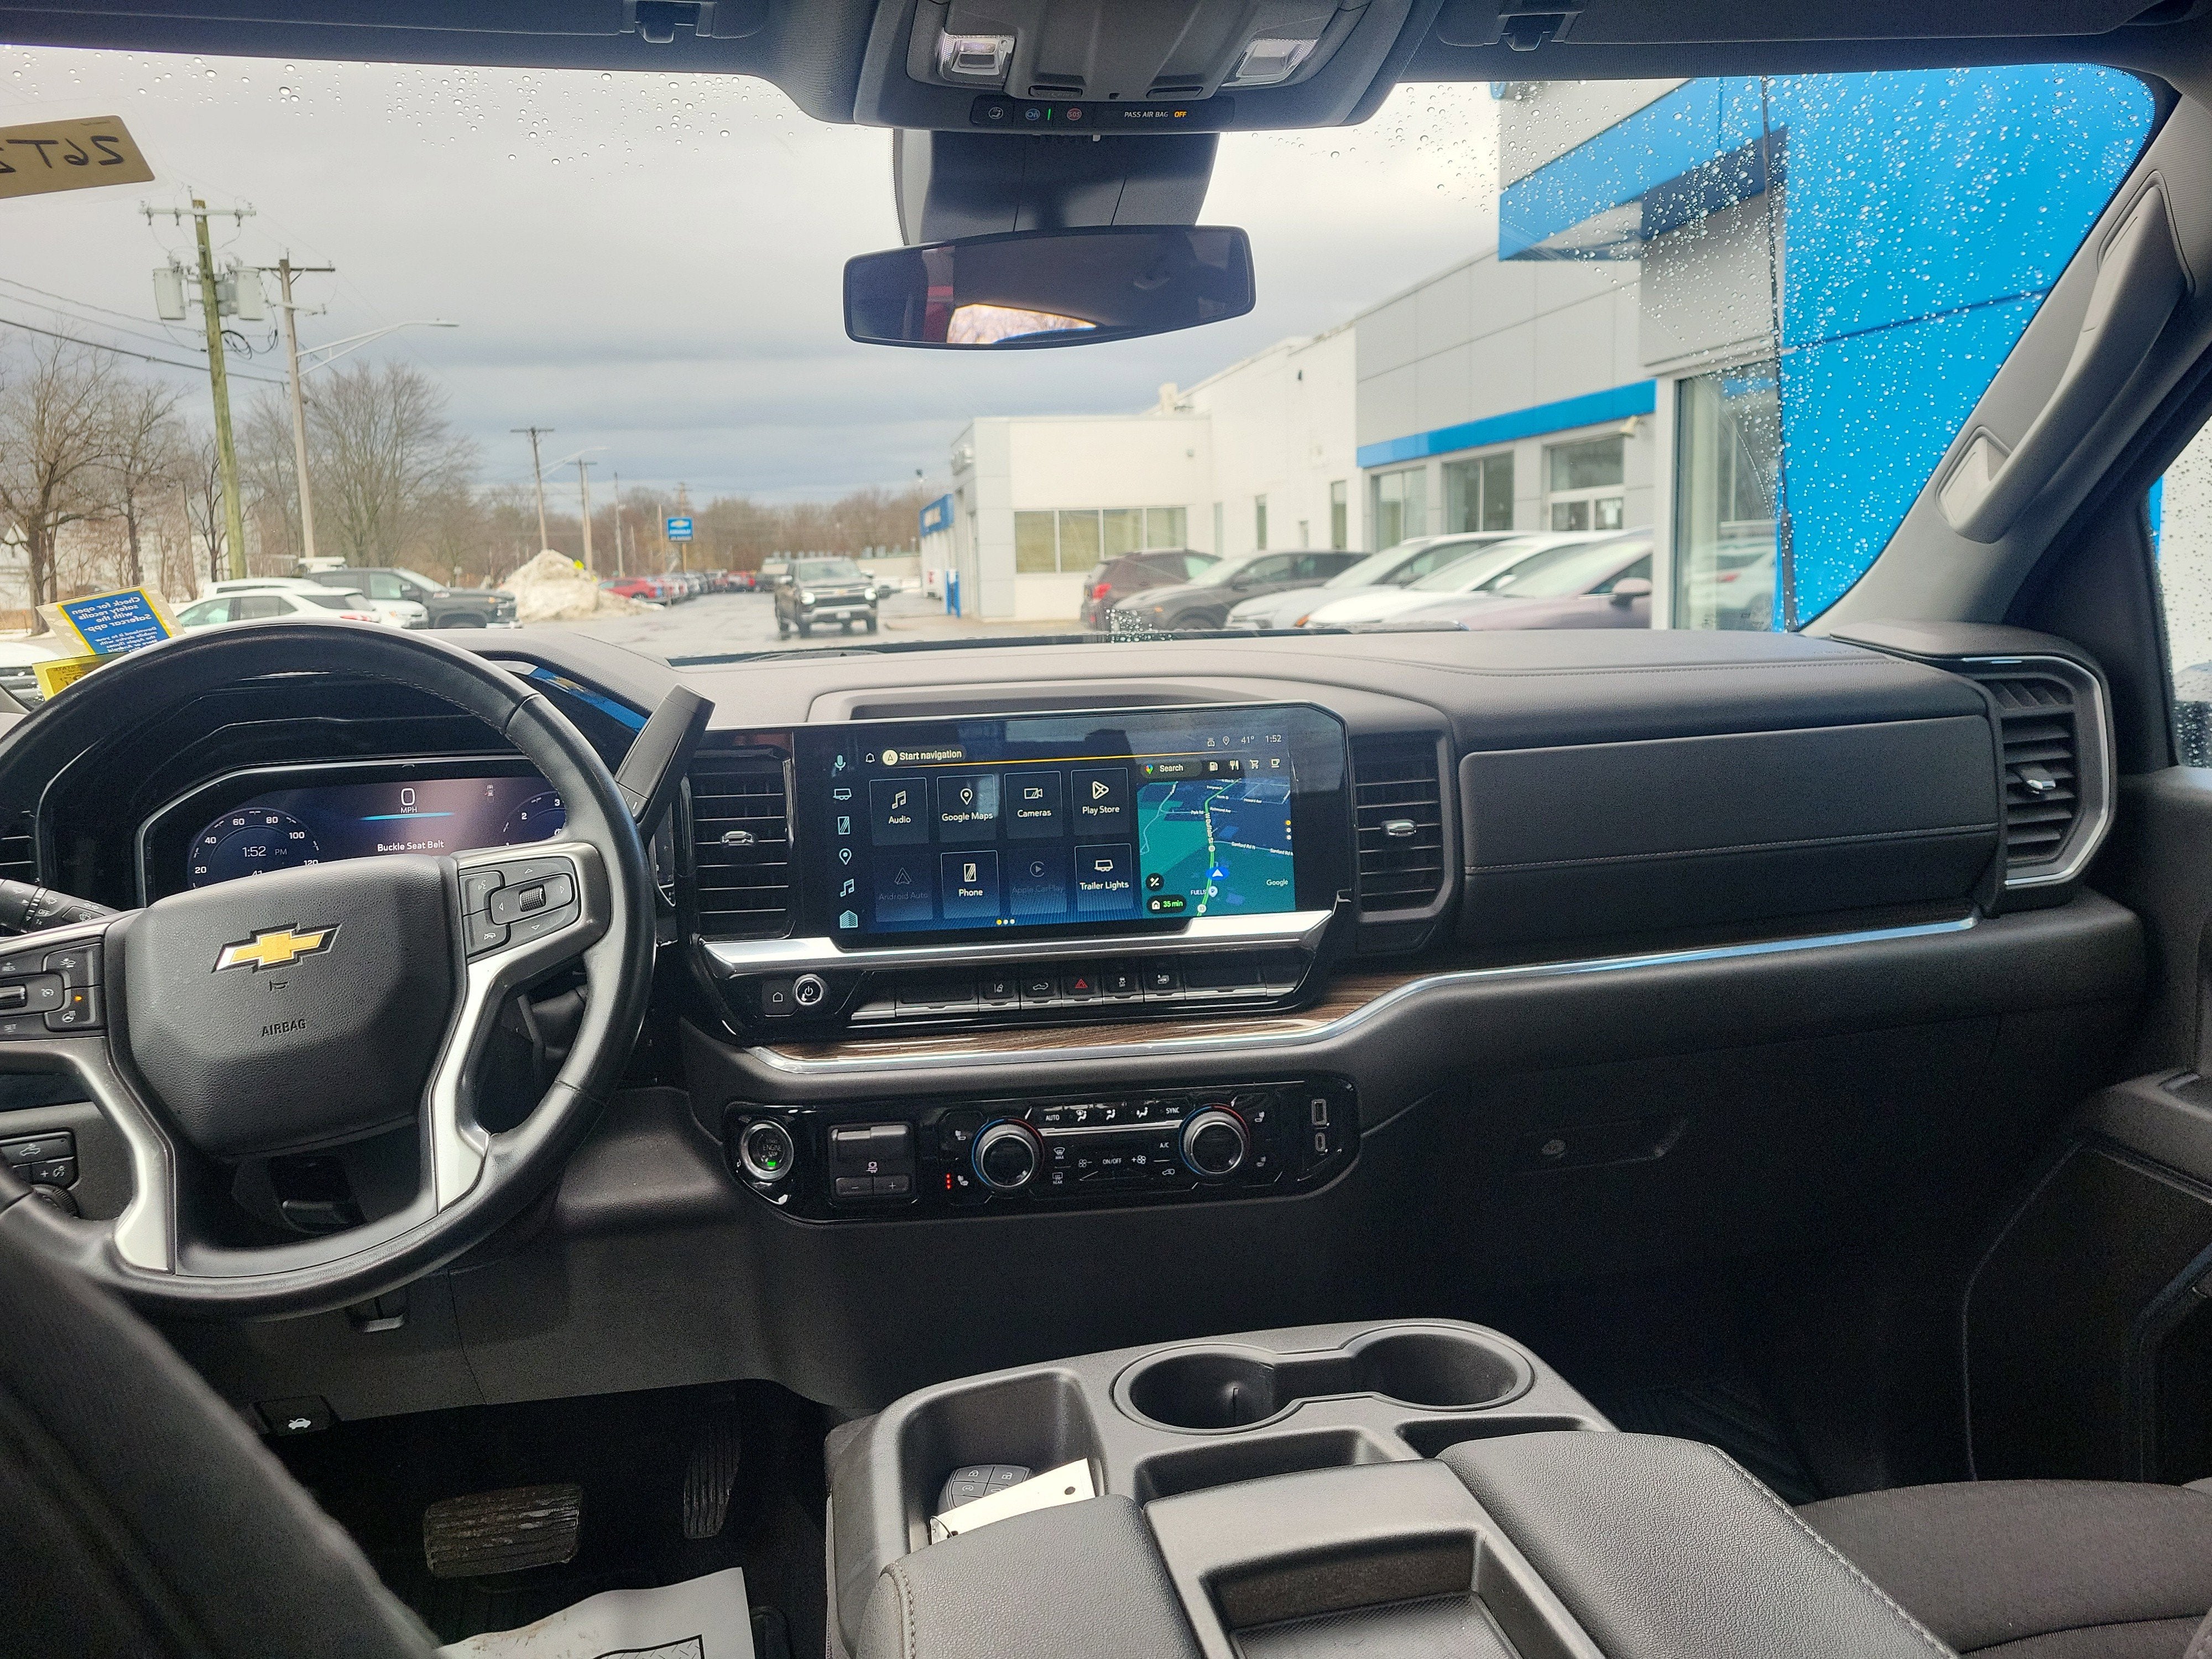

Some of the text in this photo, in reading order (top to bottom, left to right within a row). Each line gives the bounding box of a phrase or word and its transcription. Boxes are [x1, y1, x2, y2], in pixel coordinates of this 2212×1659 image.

[1241, 735, 1254, 744] 41°
[899, 750, 962, 760] Start navigation
[1159, 764, 1183, 773] Search
[401, 787, 415, 806] 0
[1017, 809, 1052, 817] Cameras
[1082, 805, 1120, 816] Play Store
[888, 816, 911, 825] Audio
[941, 812, 994, 823] Google Maps
[289, 831, 305, 839] 100
[205, 836, 216, 844] 40
[377, 839, 445, 852] Buckle Seat Belt
[242, 846, 267, 857] 1:52
[1079, 880, 1130, 891] Trailer Lights
[1266, 879, 1288, 887] Google
[879, 891, 928, 901] Android Auto
[958, 888, 983, 897] Phone
[260, 1019, 306, 1037] AIRBAG
[1166, 1107, 1180, 1115] SYNC
